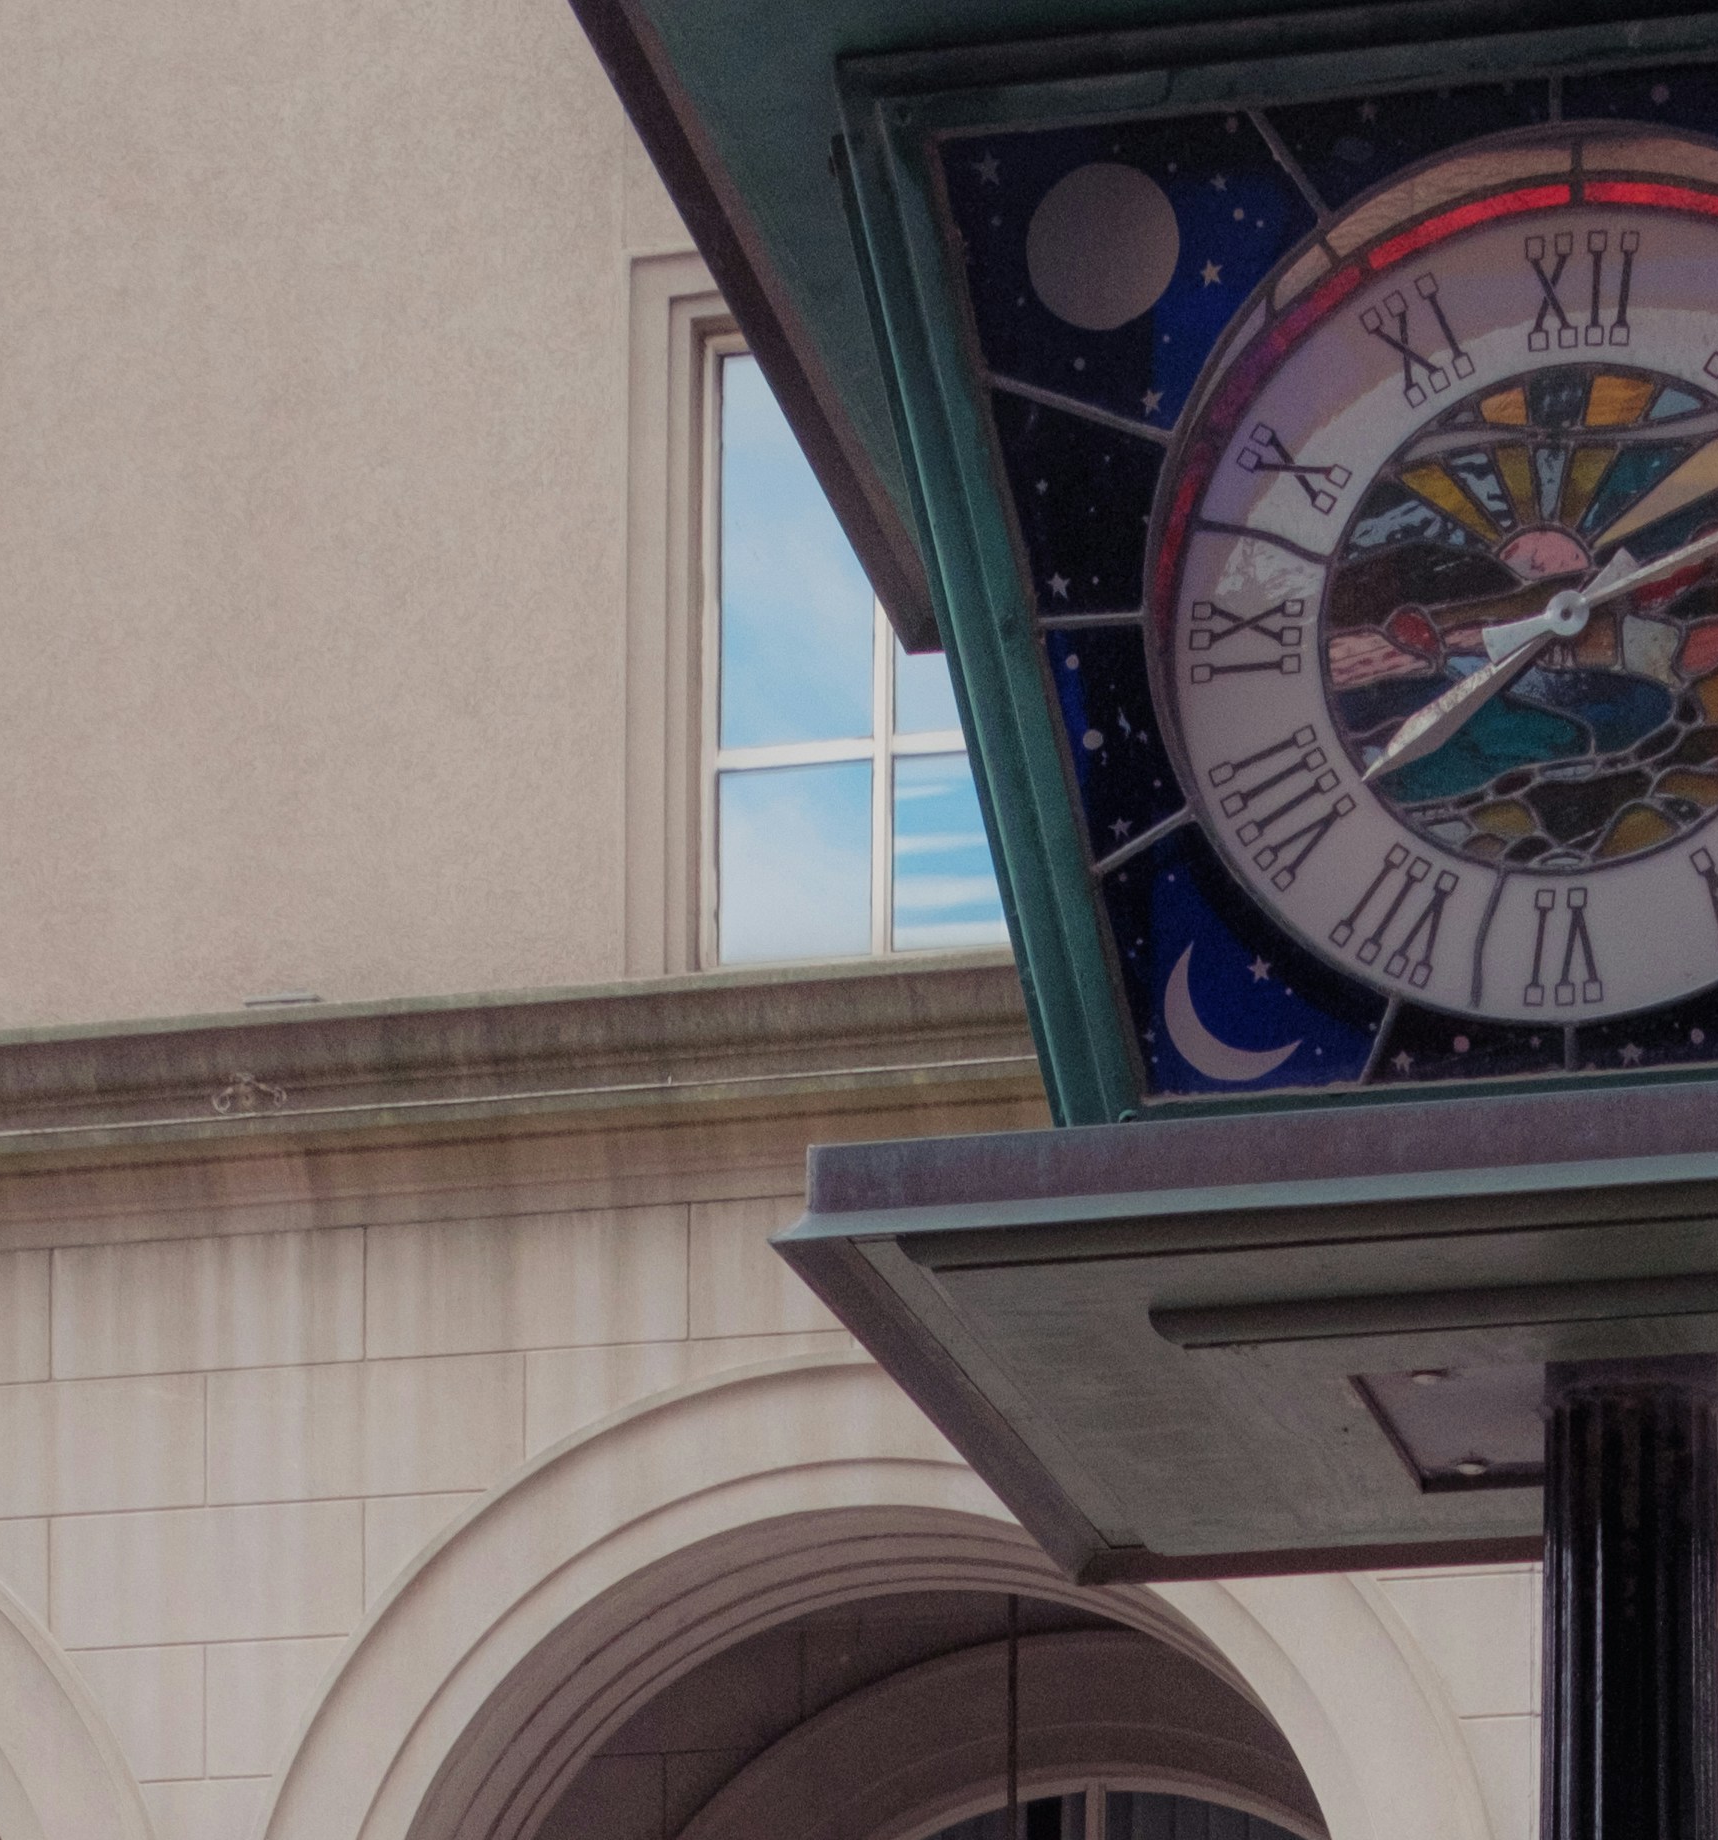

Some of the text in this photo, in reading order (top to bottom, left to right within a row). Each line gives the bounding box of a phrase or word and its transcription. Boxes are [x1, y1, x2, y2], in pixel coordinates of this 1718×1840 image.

[1360, 272, 1475, 408] XI
[1525, 230, 1640, 351] XII
[1236, 423, 1352, 514] X
[1189, 600, 1305, 683] IX
[1209, 725, 1356, 891] VIII
[1329, 843, 1459, 988] VII
[1524, 887, 1604, 1006] VI
